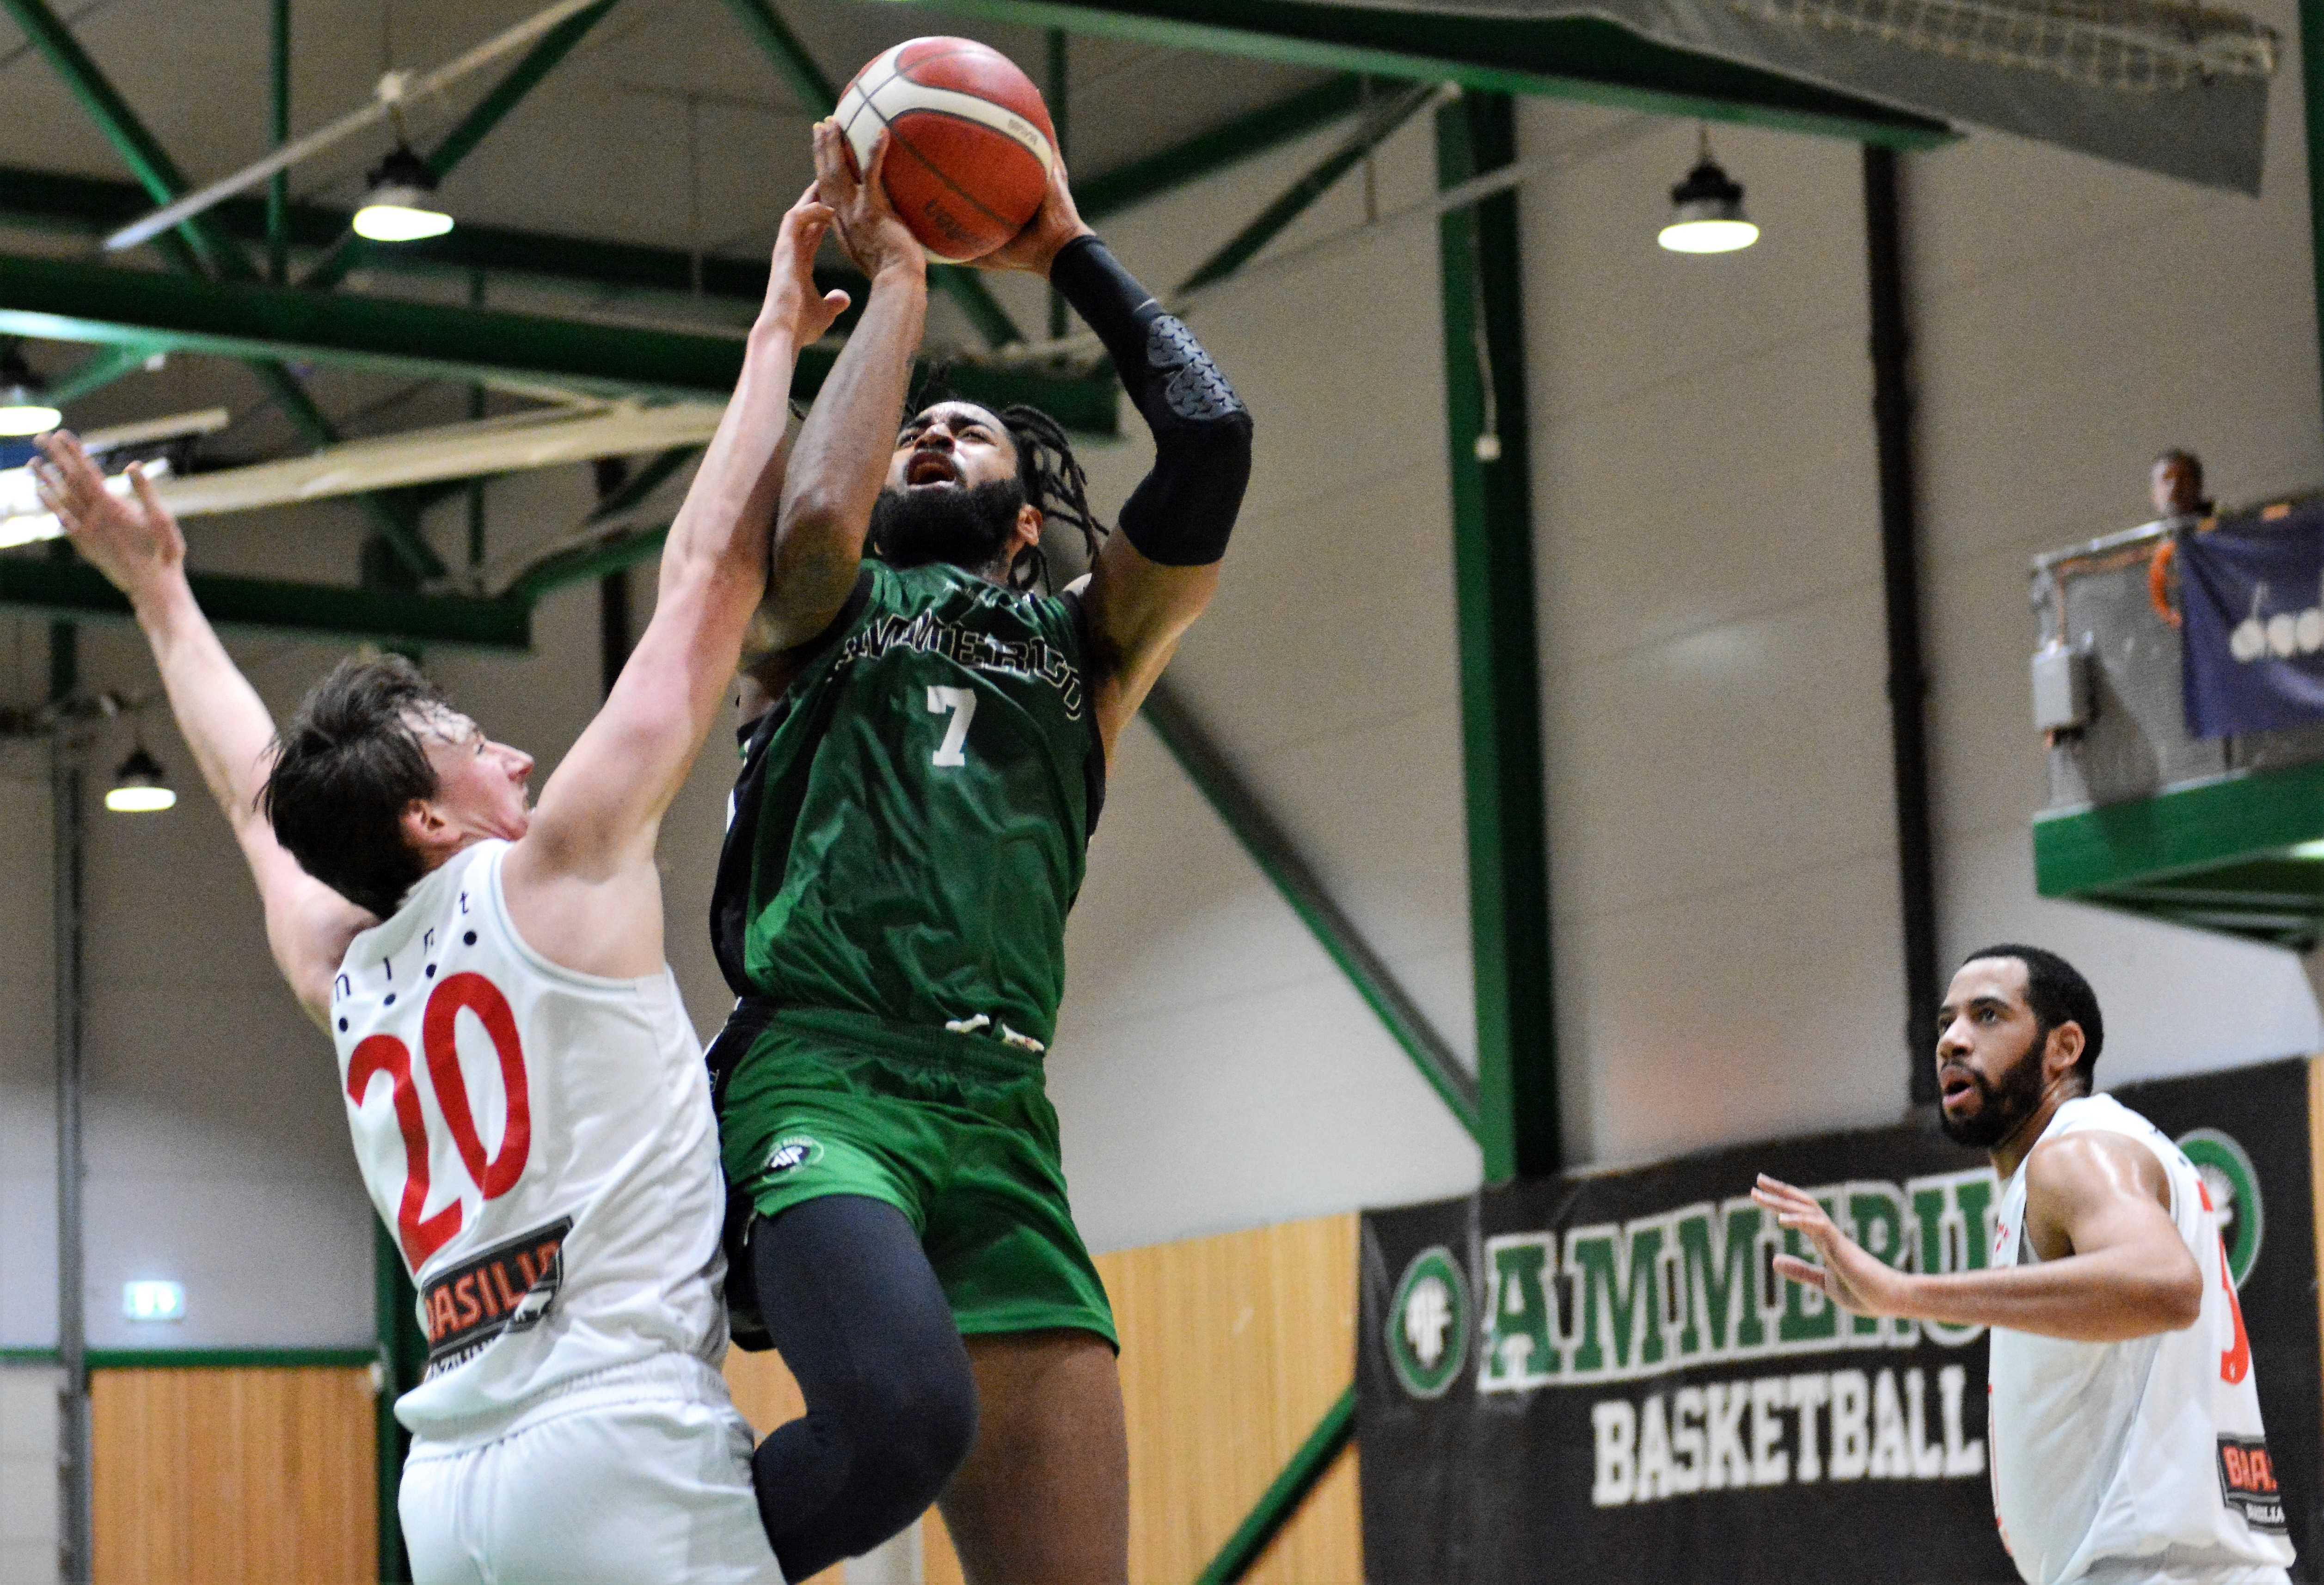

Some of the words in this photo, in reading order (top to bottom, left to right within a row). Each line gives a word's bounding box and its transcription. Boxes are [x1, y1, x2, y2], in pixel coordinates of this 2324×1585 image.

[927, 685, 977, 766] 7
[347, 971, 530, 1275] 20
[1591, 1365, 1985, 1507] BASKETBALL
